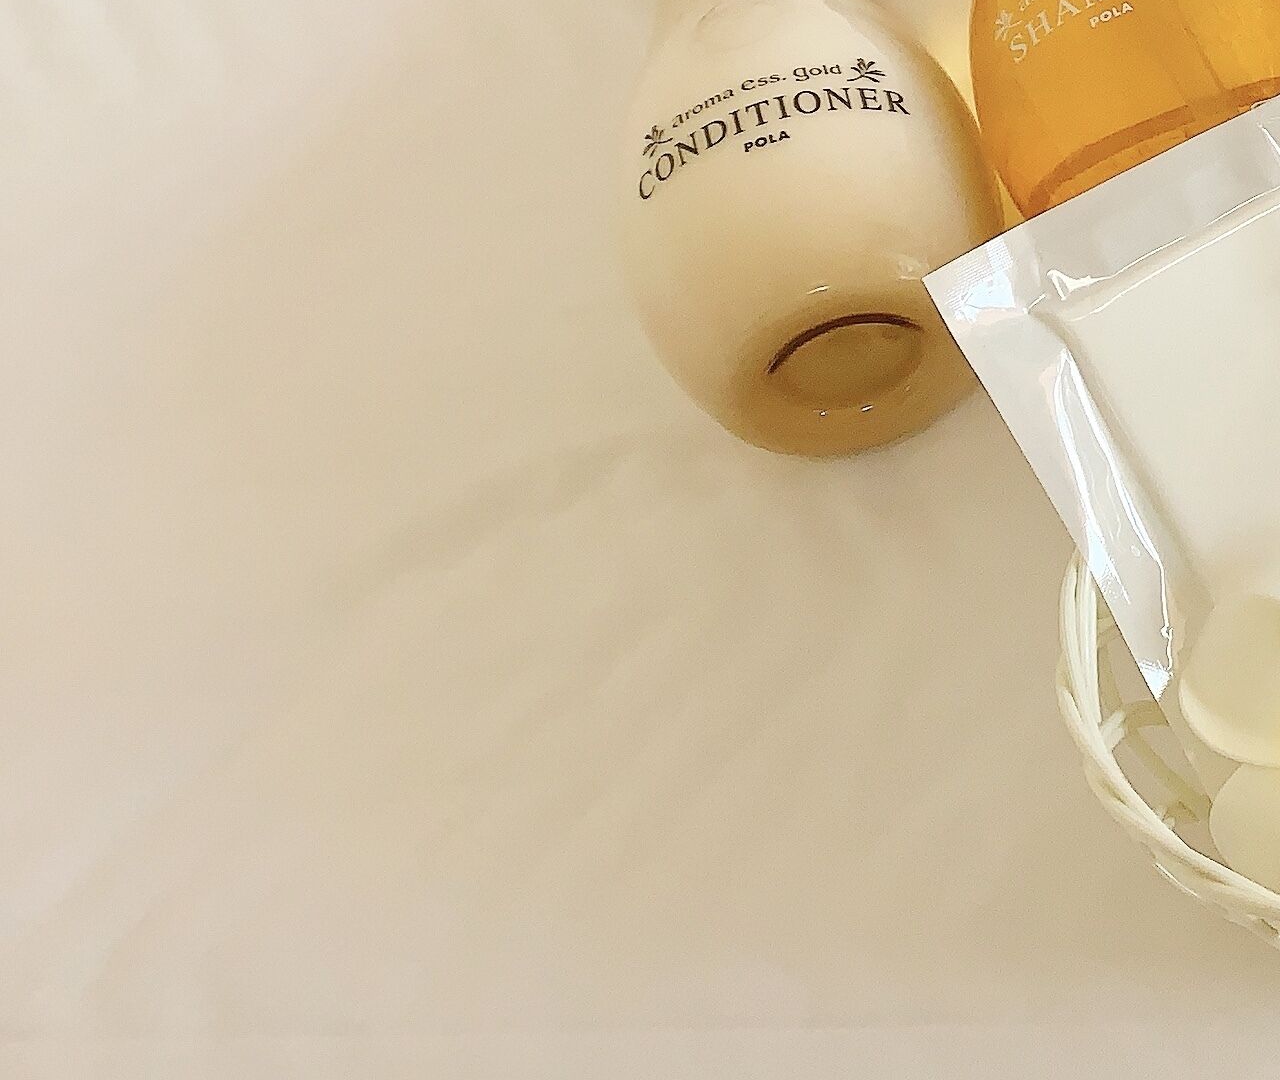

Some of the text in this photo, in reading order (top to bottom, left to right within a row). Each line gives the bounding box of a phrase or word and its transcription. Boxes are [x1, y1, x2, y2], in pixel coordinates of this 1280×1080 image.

[1089, 2, 1133, 27] POLA
[672, 64, 841, 128] aroma ess. gold
[639, 87, 911, 200] CONDITIONER
[744, 129, 790, 152] POLA
